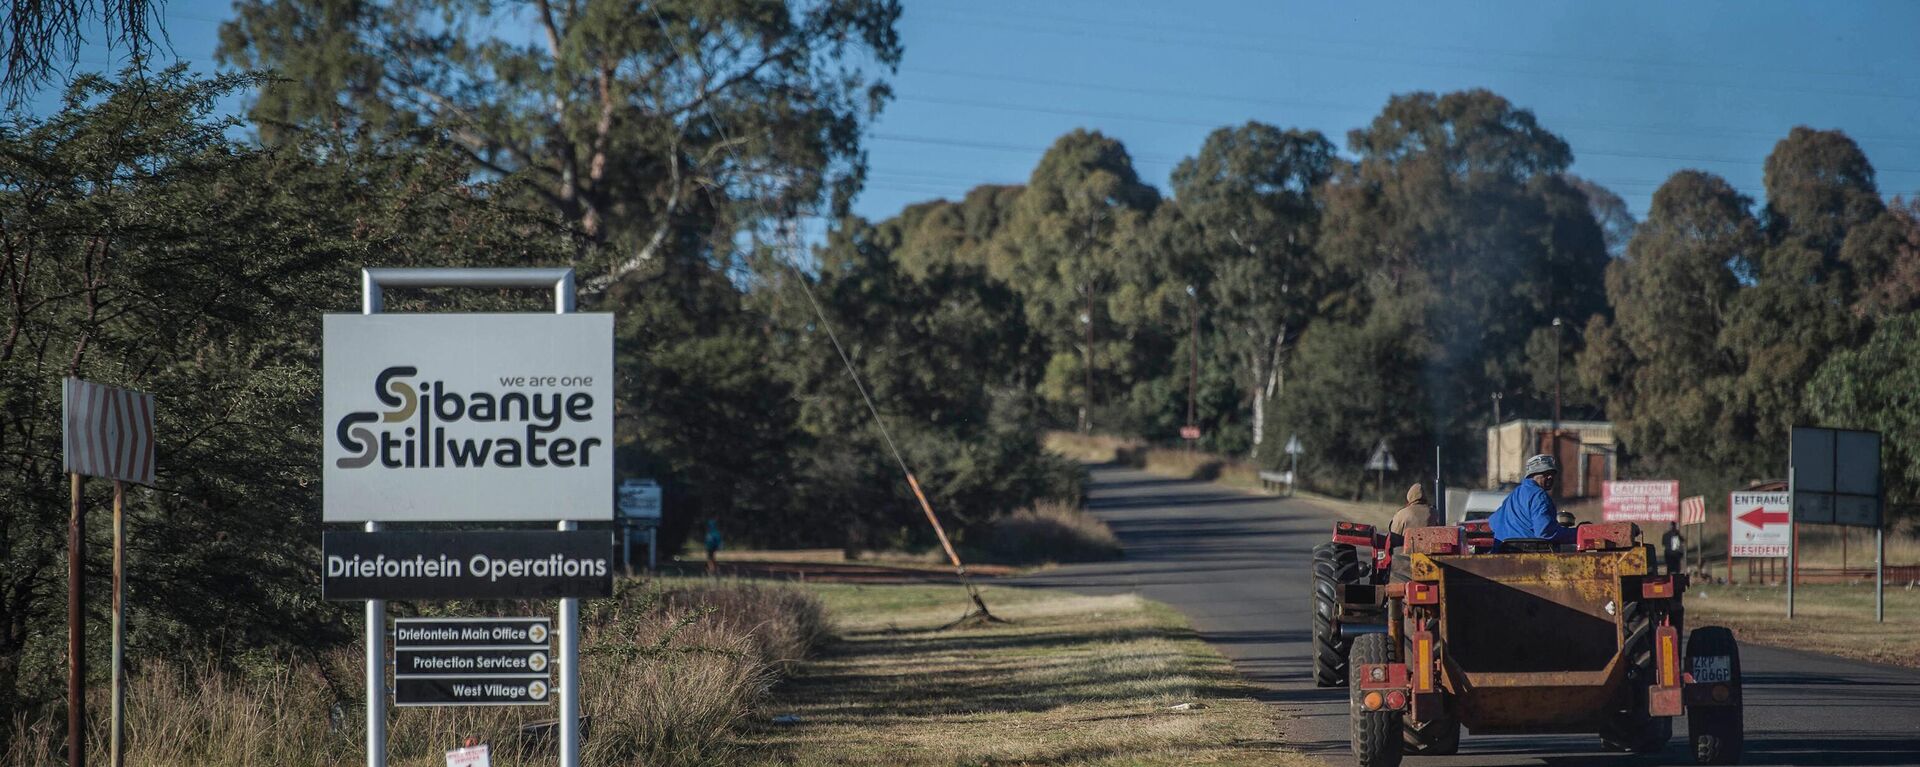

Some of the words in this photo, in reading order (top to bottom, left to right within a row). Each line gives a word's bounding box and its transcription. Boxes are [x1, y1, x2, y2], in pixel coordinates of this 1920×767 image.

[499, 376, 525, 388] we
[529, 376, 556, 388] are
[560, 376, 593, 388] one
[375, 366, 594, 433] Sibanye
[336, 412, 602, 469] Stillwater
[1733, 546, 1790, 555] RESIDENT
[328, 554, 461, 578] Driefontein
[469, 554, 607, 581] Operations
[398, 628, 459, 641] Driefontein
[462, 628, 490, 640] Main
[492, 627, 527, 640] Office
[413, 656, 474, 669] Protection
[477, 656, 527, 668] Services
[453, 685, 483, 697] West
[485, 684, 527, 699] Village
